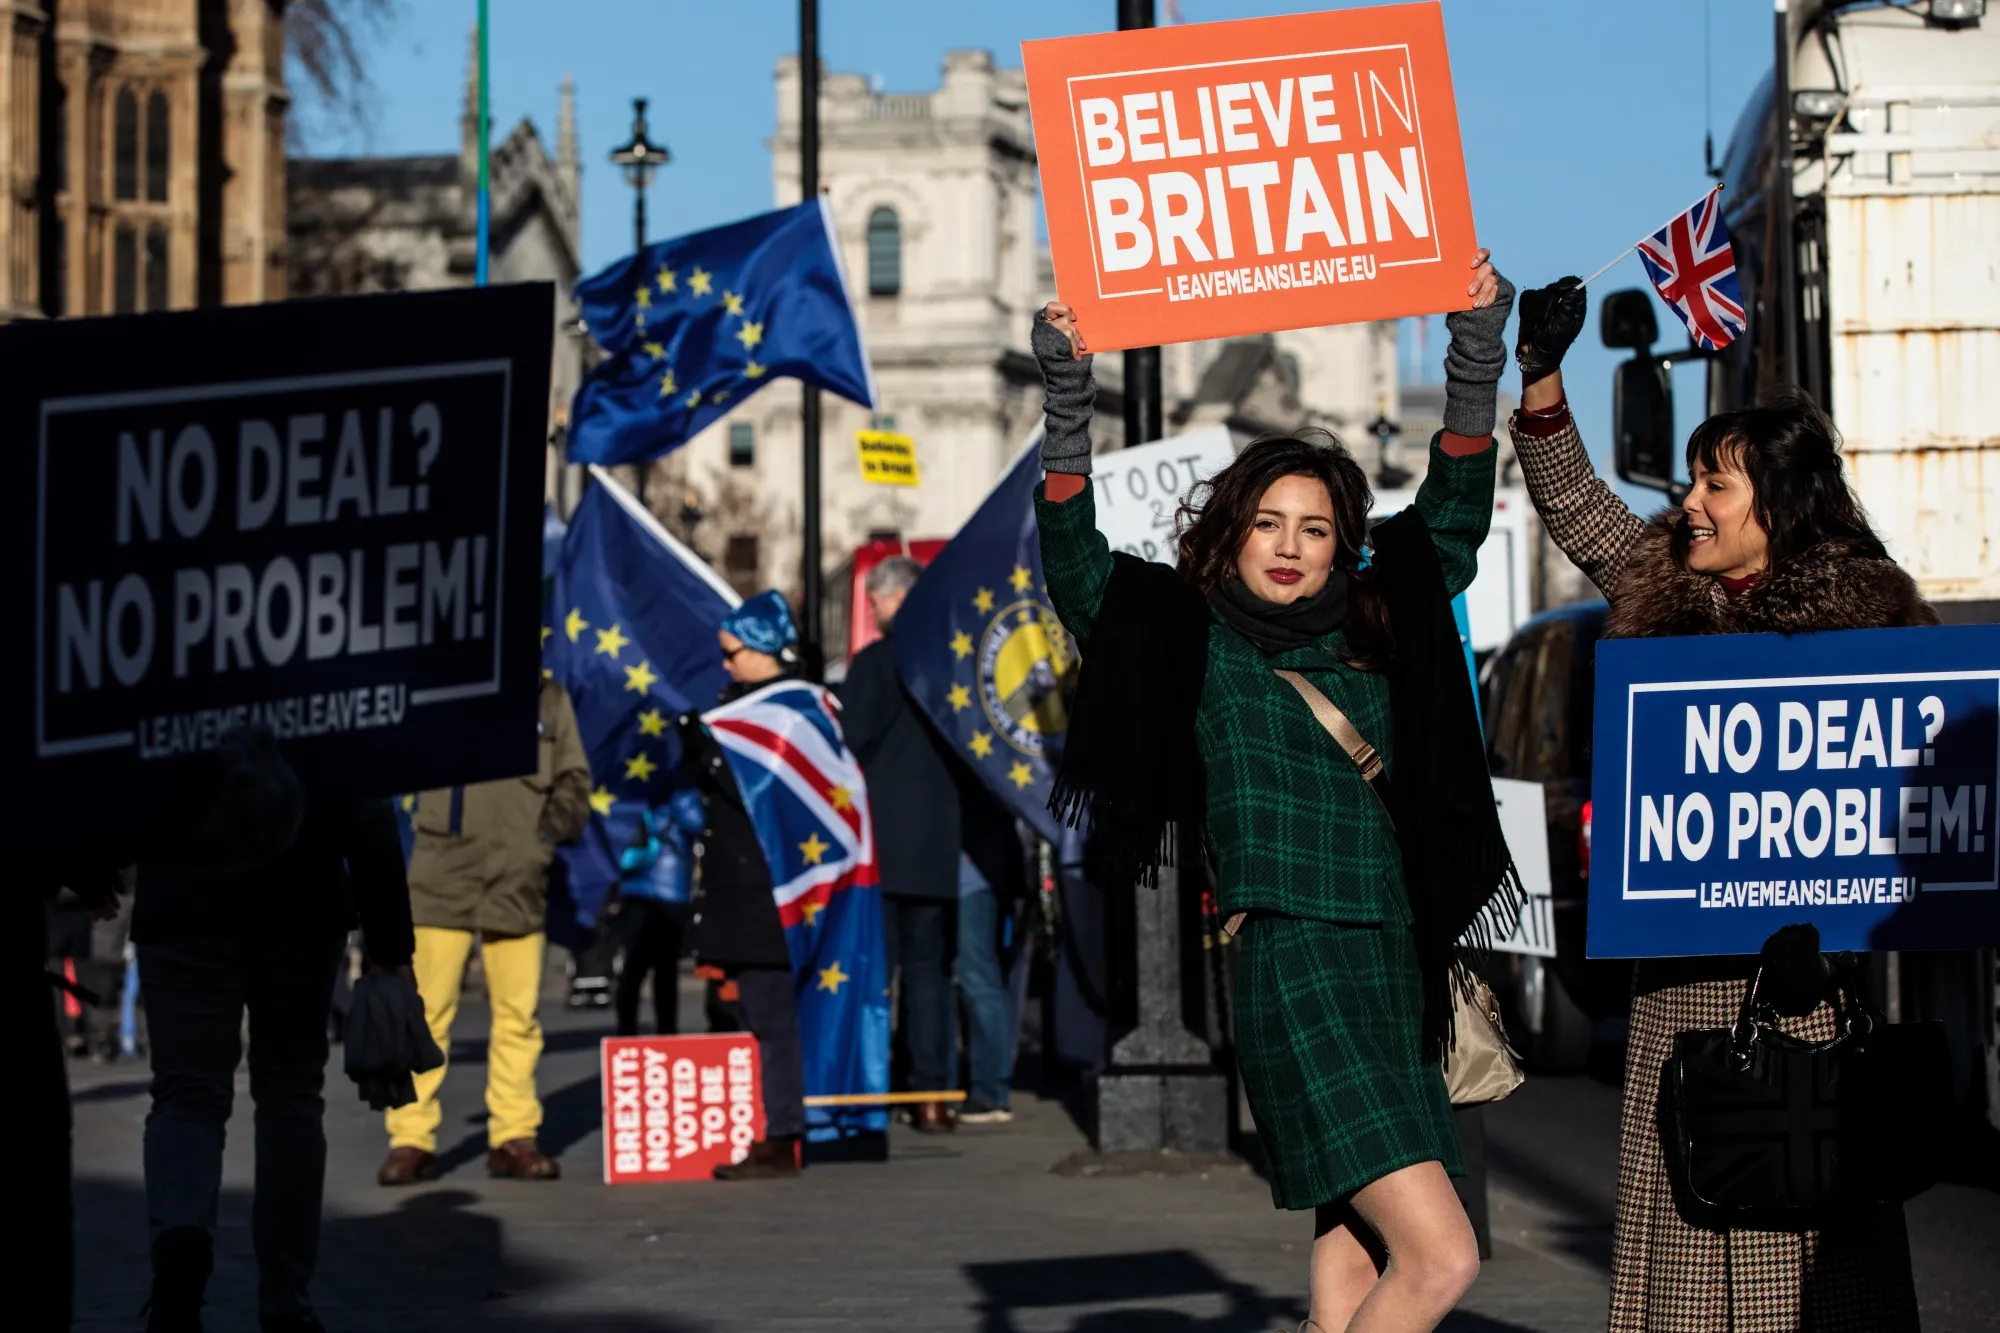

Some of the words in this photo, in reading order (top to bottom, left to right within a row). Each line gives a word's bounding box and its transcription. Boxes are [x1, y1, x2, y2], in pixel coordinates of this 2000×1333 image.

[1080, 74, 1342, 167] BELIEVE
[1354, 67, 1413, 139] IN
[1091, 147, 1429, 273] BRITAIN
[1166, 255, 1377, 302] LEAVEMEANSLEAVE.EU
[116, 424, 217, 545] NO
[236, 401, 443, 531] DEAL?
[57, 573, 156, 693] NO
[173, 534, 488, 678] PROBLEM!
[1685, 702, 1762, 774] NO
[1778, 695, 1945, 772] DEAL?
[1639, 792, 1714, 862] NO
[1728, 784, 1987, 860] PROBLEM!
[1700, 876, 1916, 908] LEAVEMEANSLEAVE.EU
[612, 1047, 642, 1173] BREXIT:
[643, 1047, 671, 1172] NOBODY
[672, 1058, 698, 1159] VOTED
[701, 1065, 725, 1104] BE
[702, 1106, 726, 1149] TO
